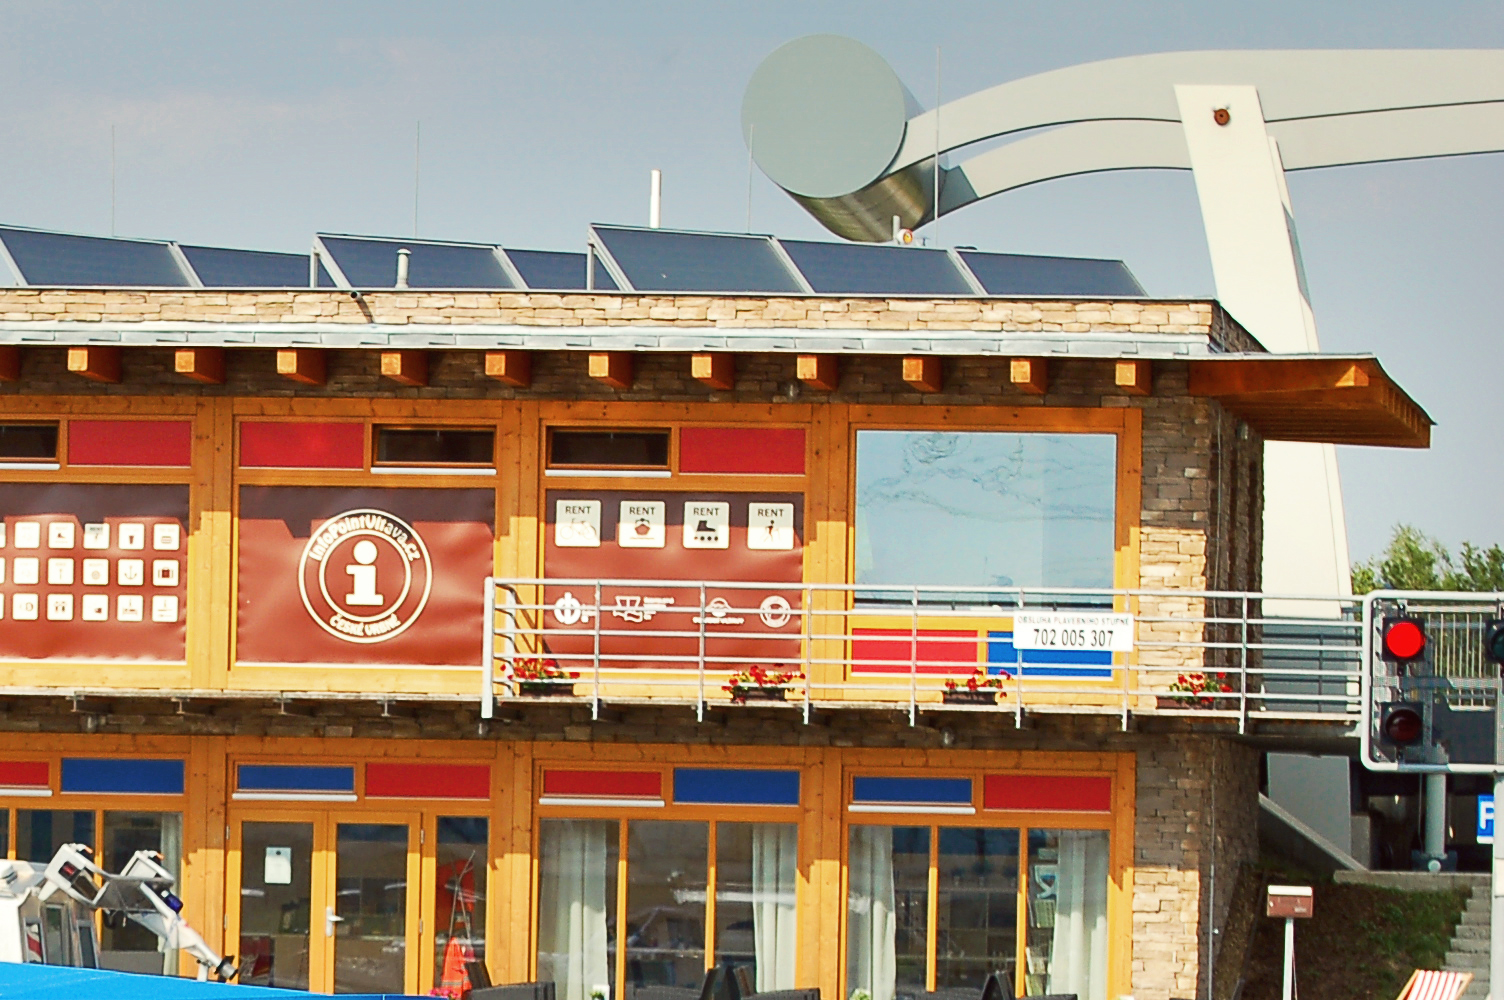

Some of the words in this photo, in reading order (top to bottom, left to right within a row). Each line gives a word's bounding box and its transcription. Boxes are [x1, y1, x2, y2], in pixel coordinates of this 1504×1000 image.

[565, 505, 592, 515] RENT
[629, 506, 656, 516] RENT
[693, 507, 720, 517] RENT
[757, 508, 784, 518] RENT
[1033, 628, 1057, 646] 702
[1061, 629, 1085, 647] 005
[1090, 629, 1114, 647] 307
